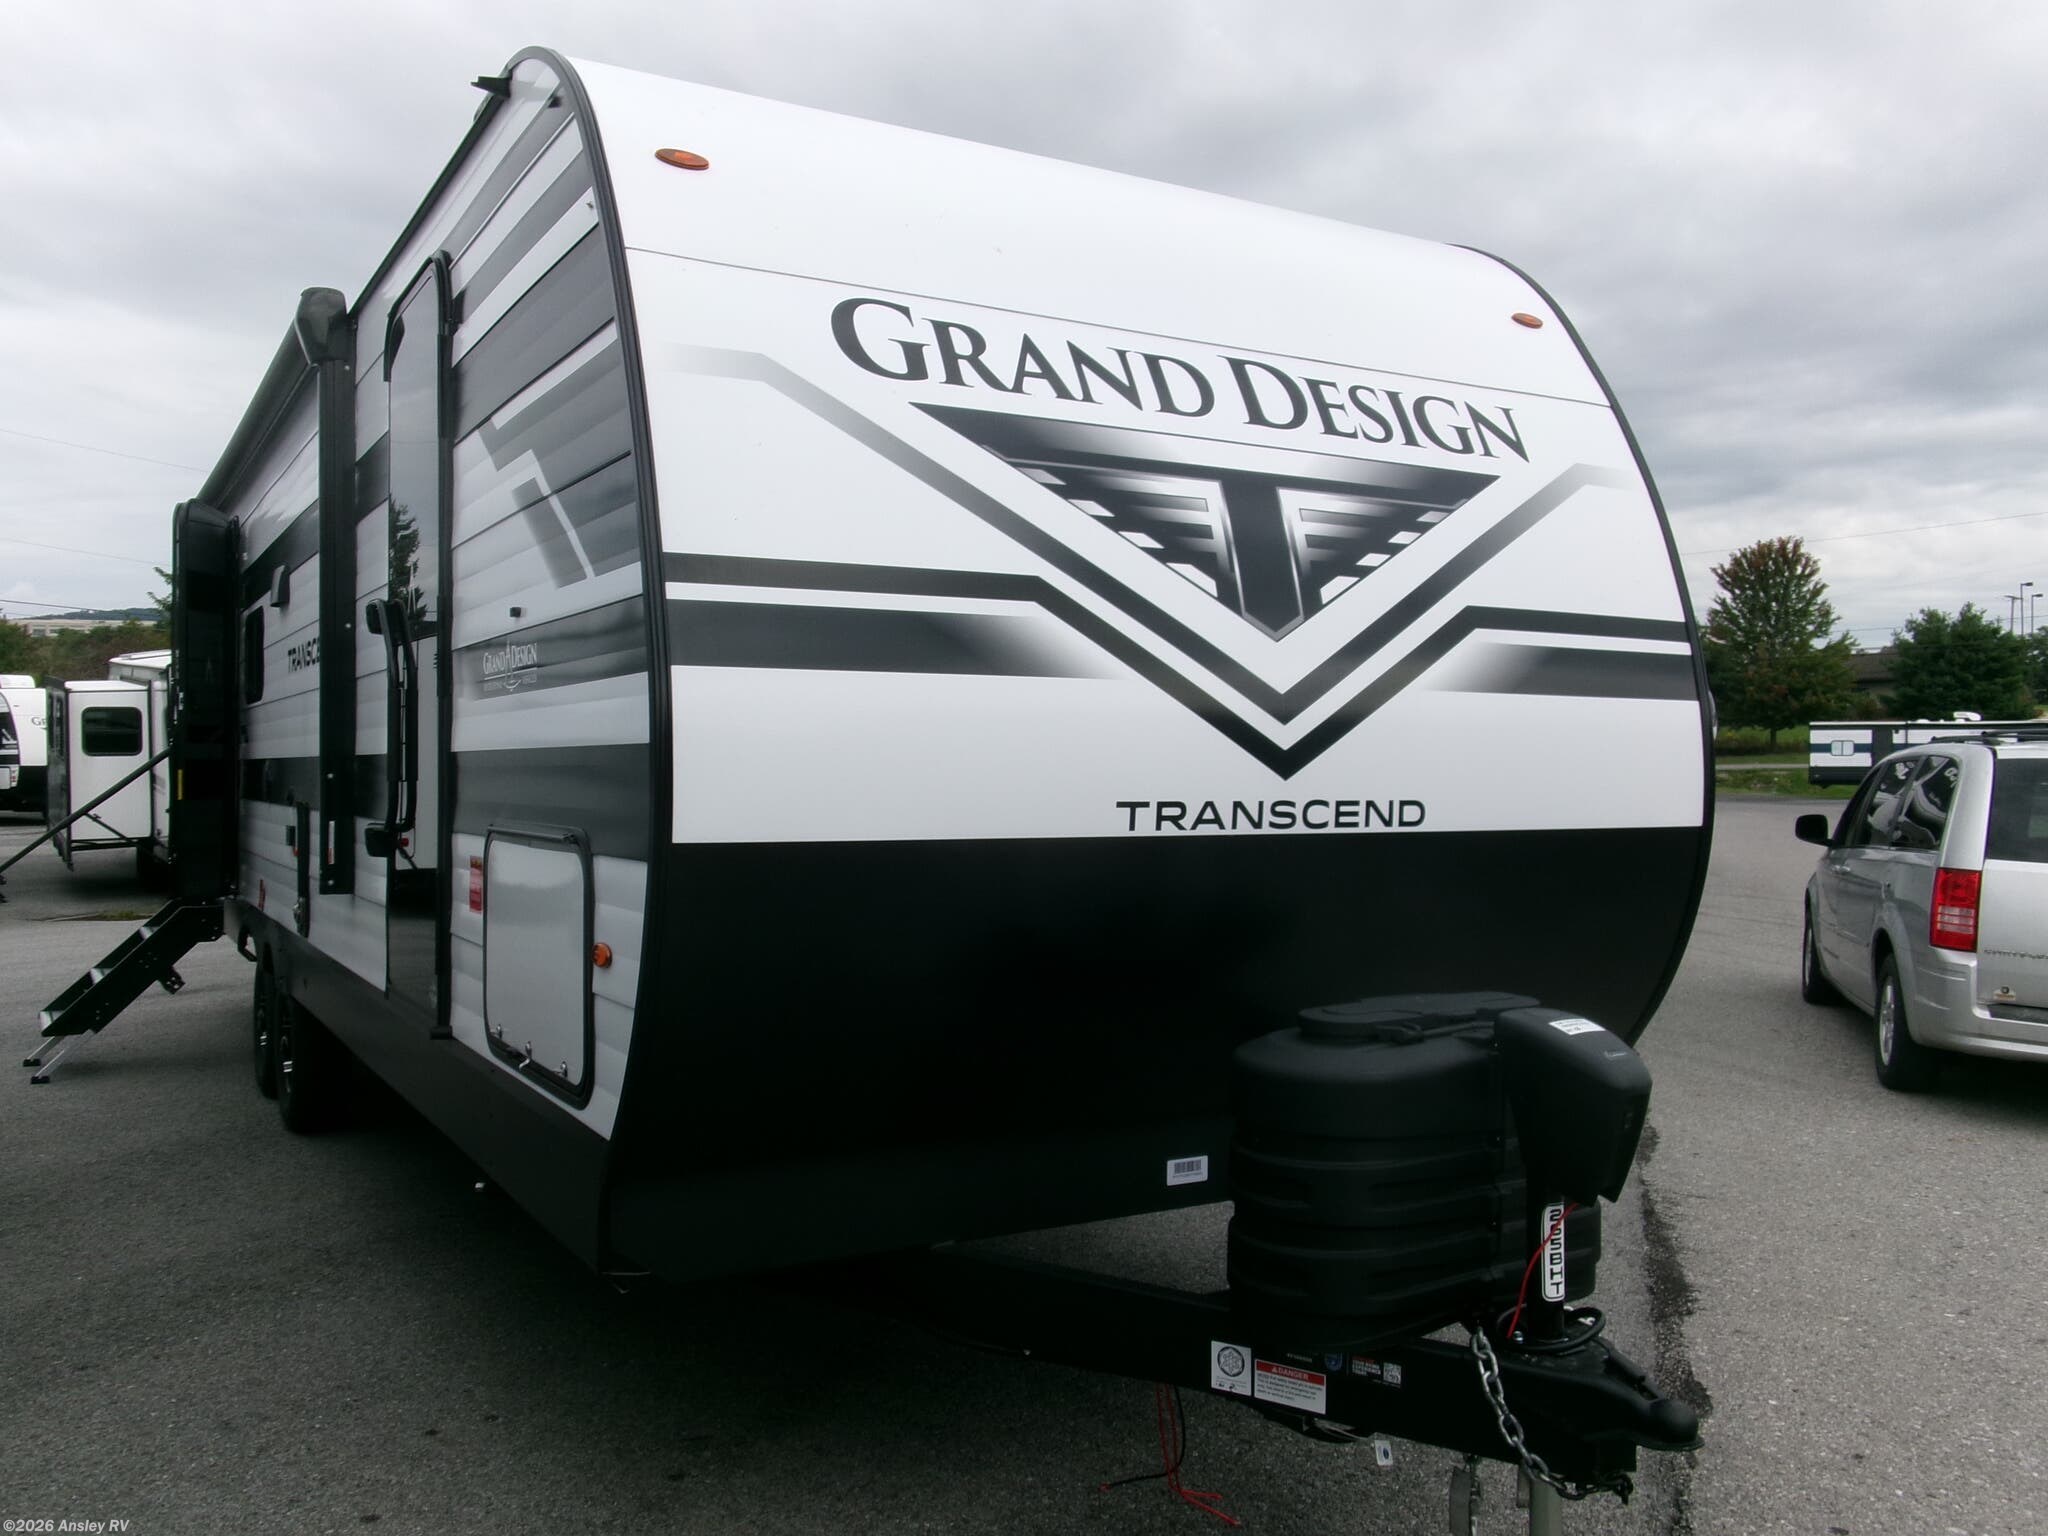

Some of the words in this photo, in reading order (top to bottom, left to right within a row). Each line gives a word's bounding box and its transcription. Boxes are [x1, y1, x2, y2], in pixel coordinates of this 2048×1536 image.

[830, 297, 1215, 418] GRAND
[1217, 354, 1530, 464] DESIGN
[1115, 799, 1426, 831] TRANSCEND
